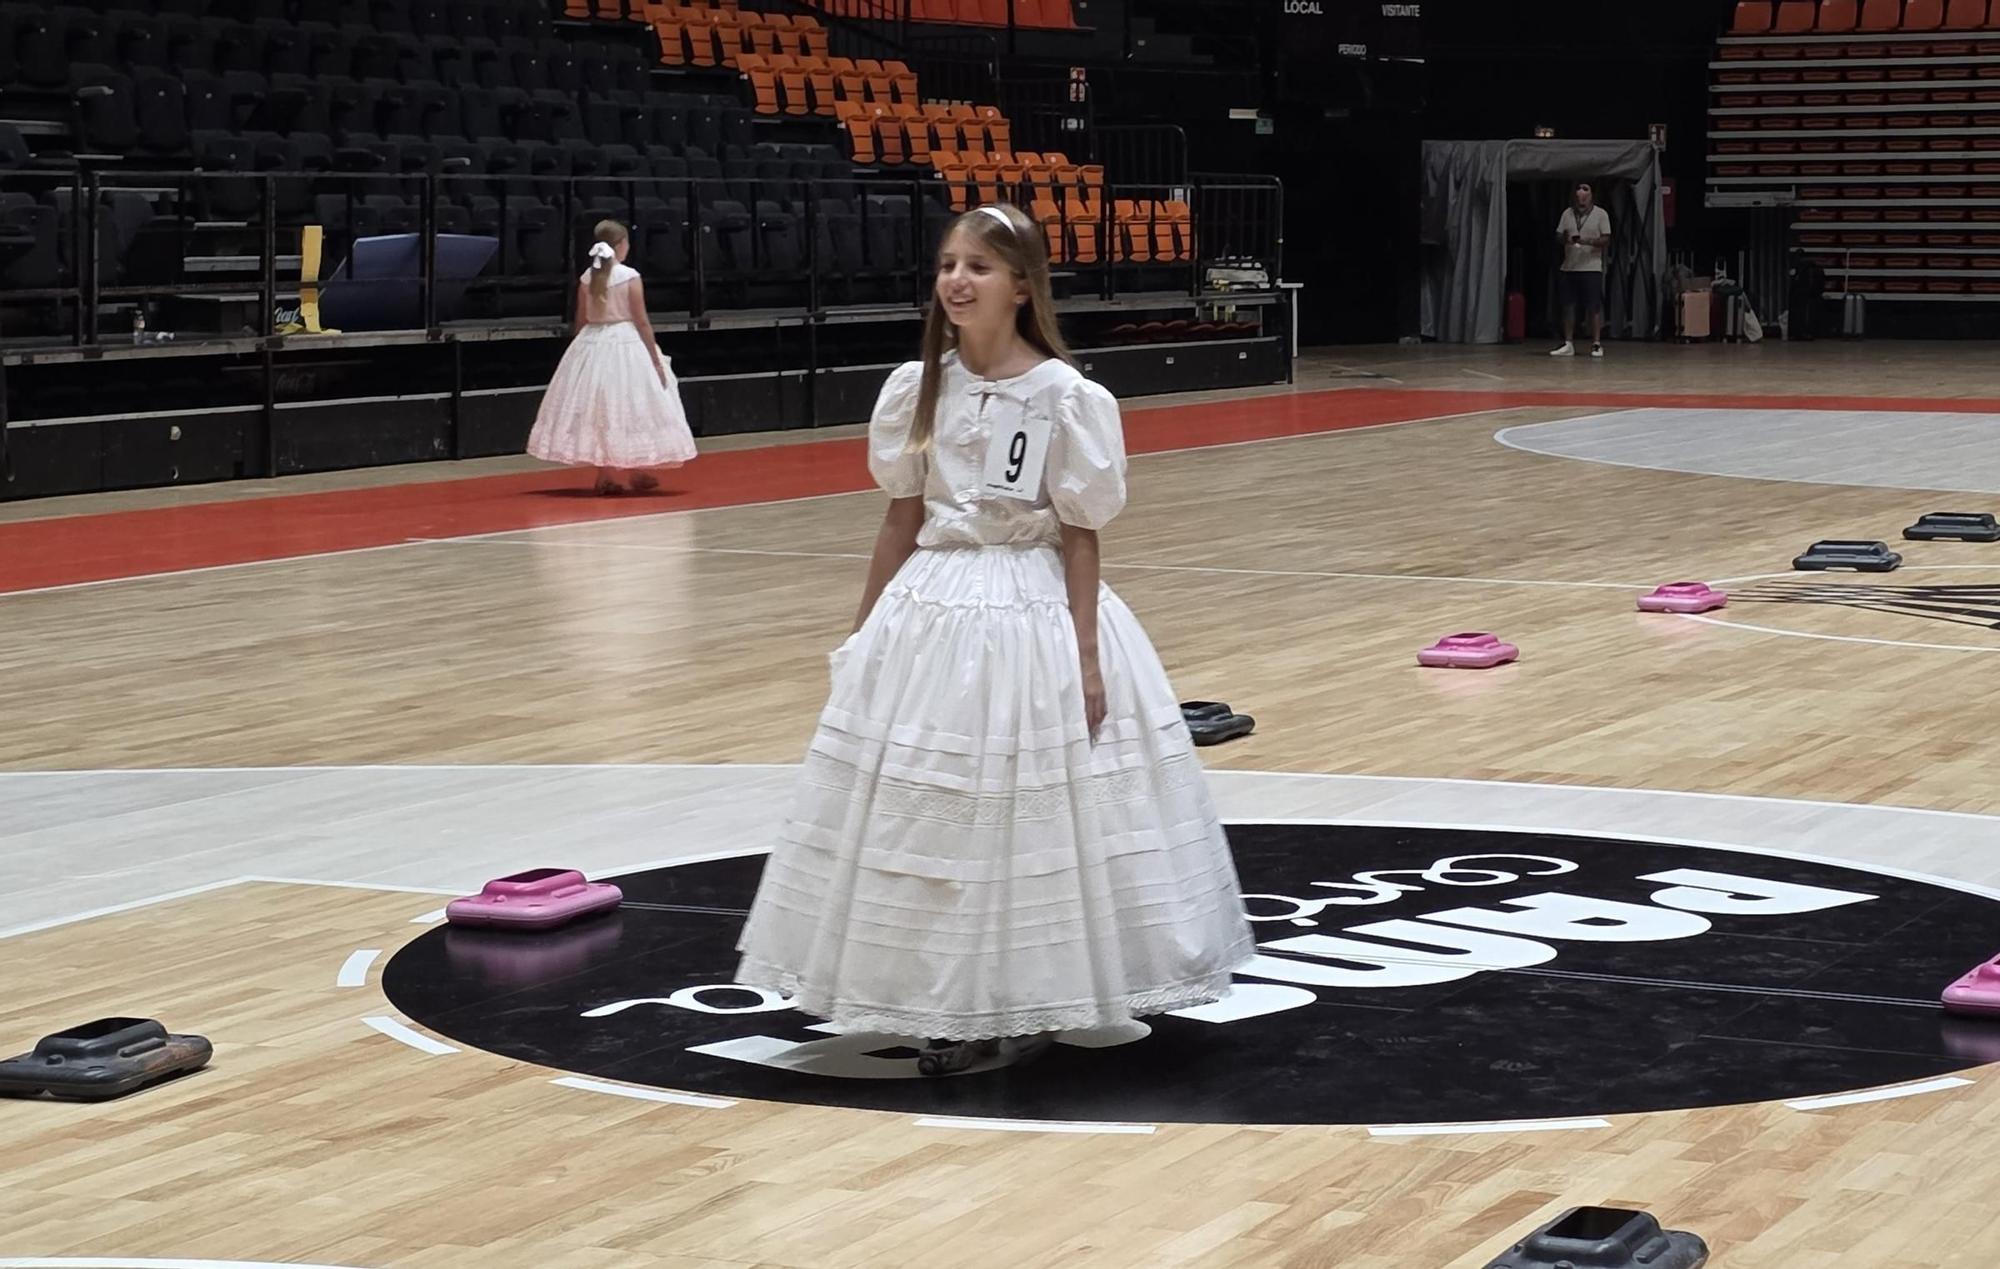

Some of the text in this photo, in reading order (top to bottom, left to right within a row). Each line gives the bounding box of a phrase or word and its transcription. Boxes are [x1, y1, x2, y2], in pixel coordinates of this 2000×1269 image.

[1284, 0, 1323, 14] LOCAL
[1381, 4, 1420, 17] VISITANTE
[1005, 431, 1027, 483] 9
